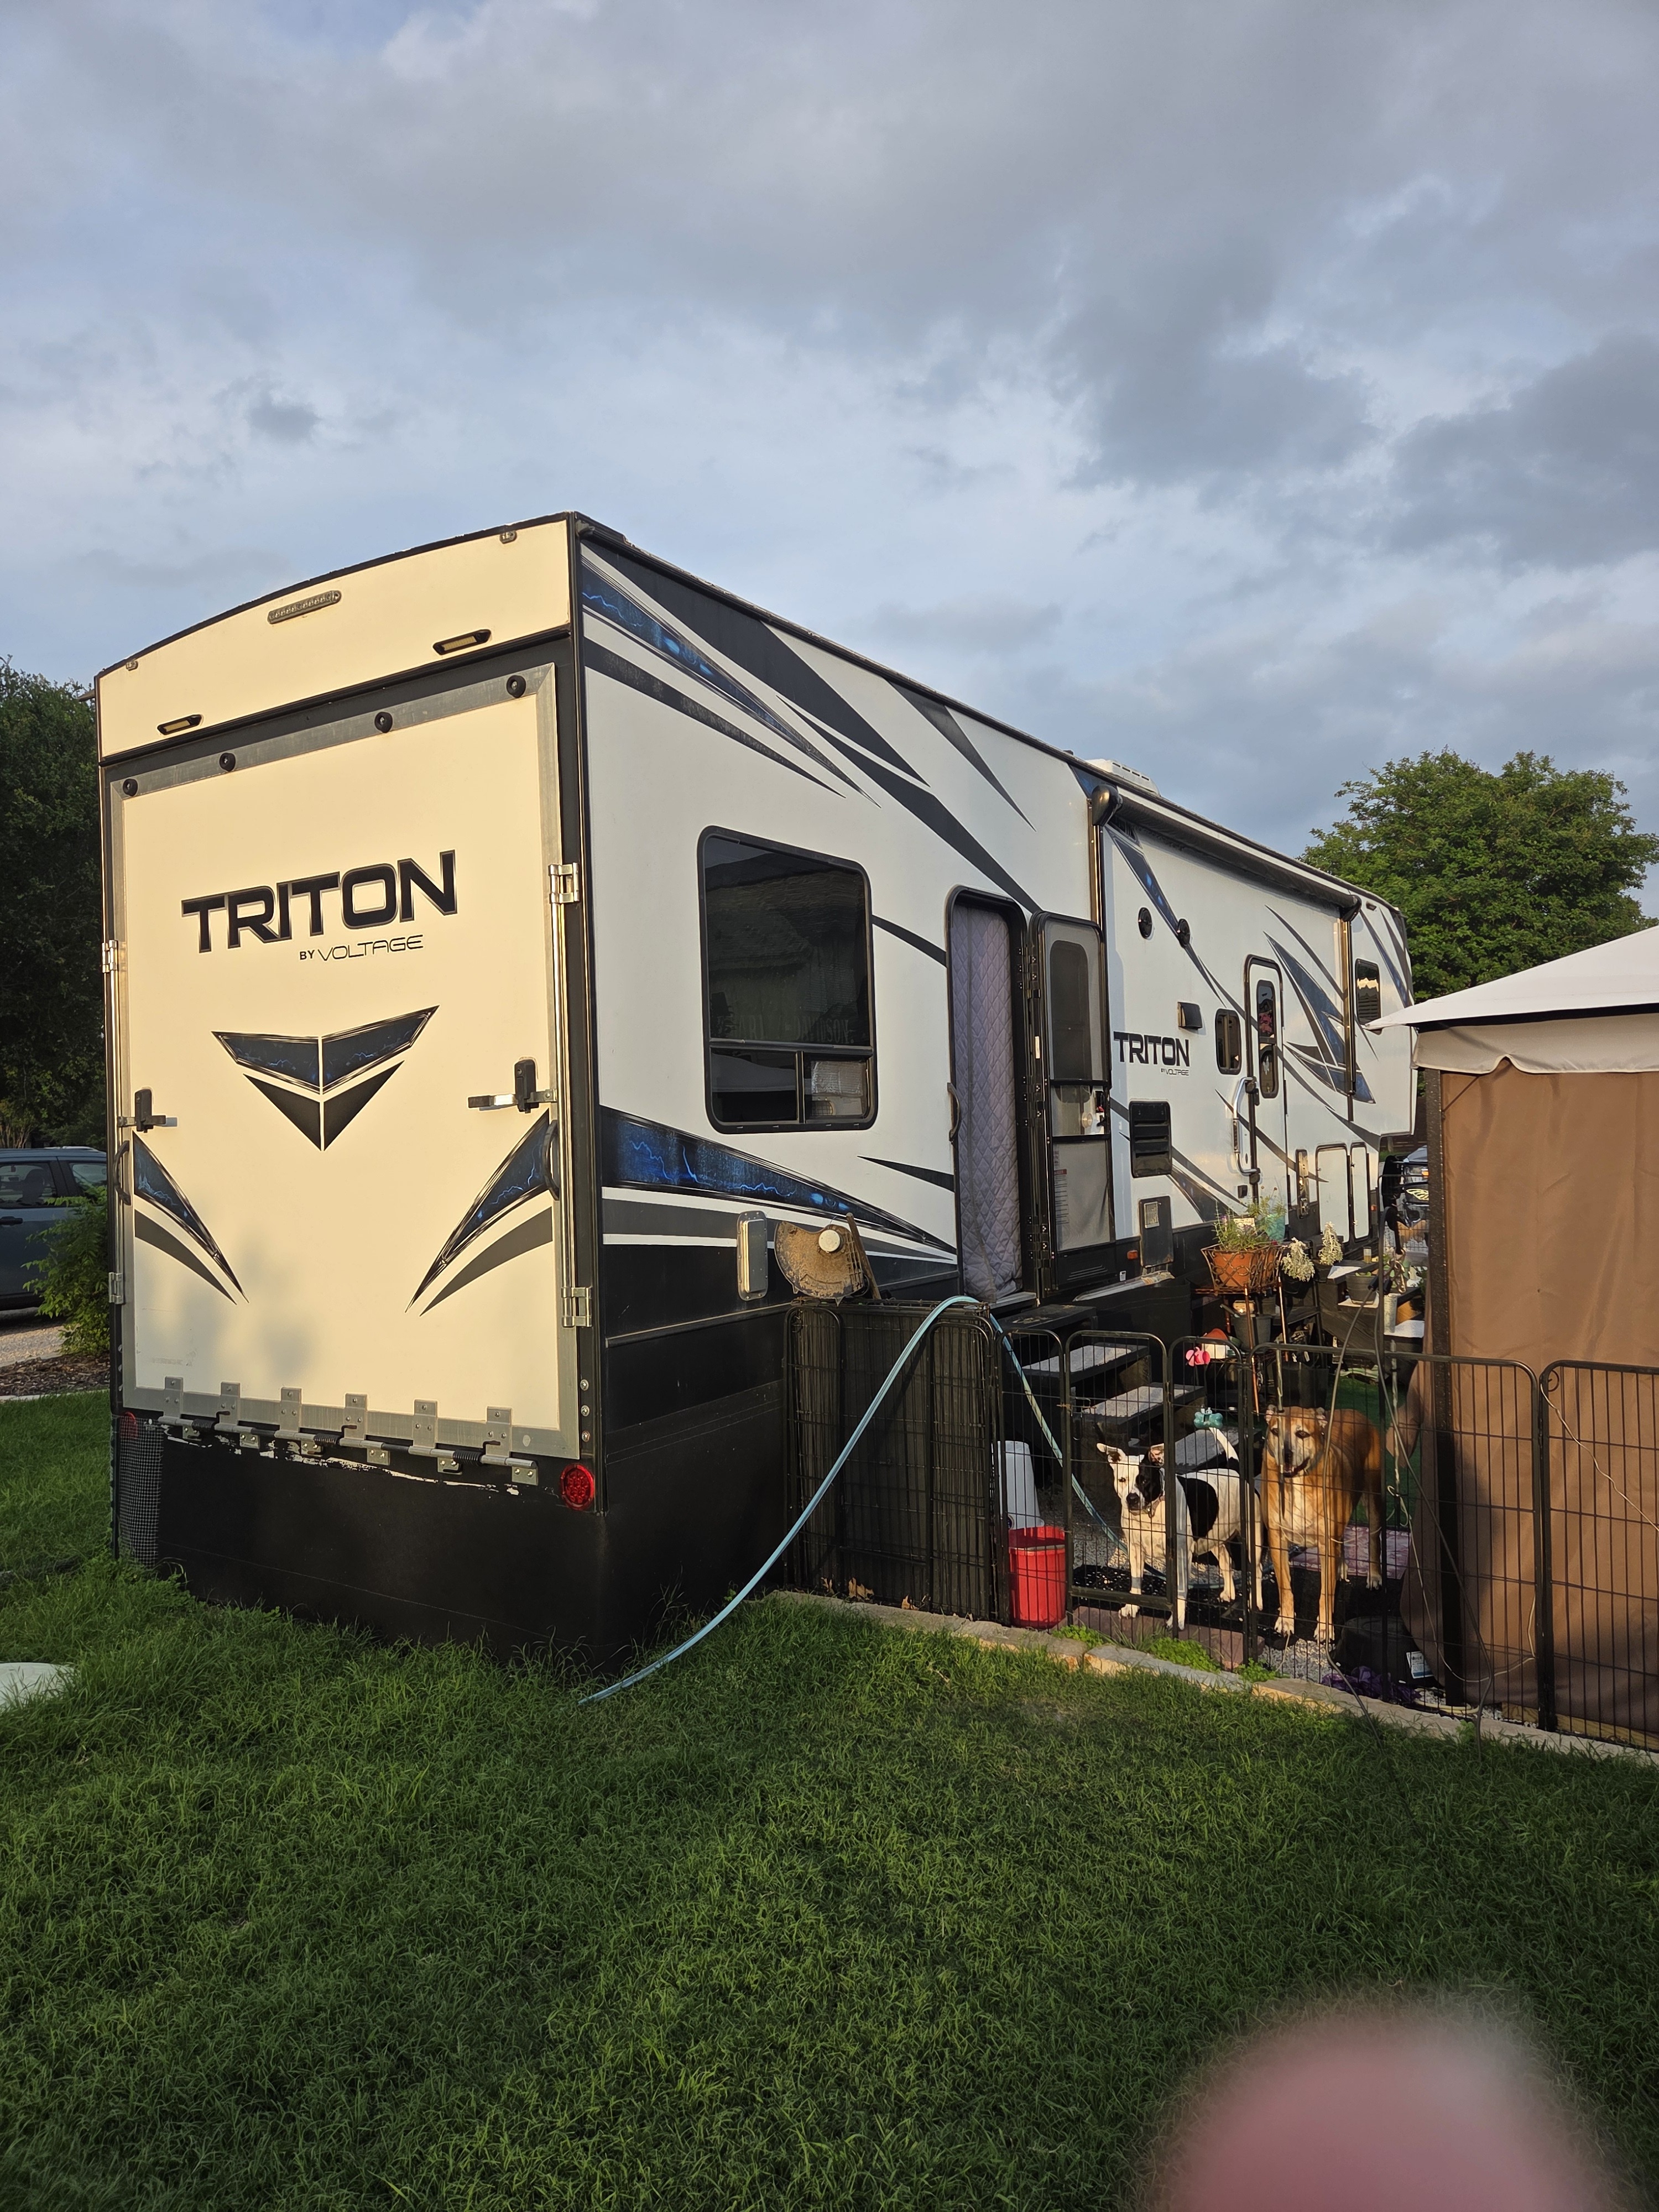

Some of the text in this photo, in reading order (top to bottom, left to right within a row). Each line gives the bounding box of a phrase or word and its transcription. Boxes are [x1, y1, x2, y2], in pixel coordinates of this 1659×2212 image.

[181, 849, 458, 954] TRITON
[300, 934, 424, 961] BY VOLTAGE
[1113, 1031, 1190, 1067] TRITON
